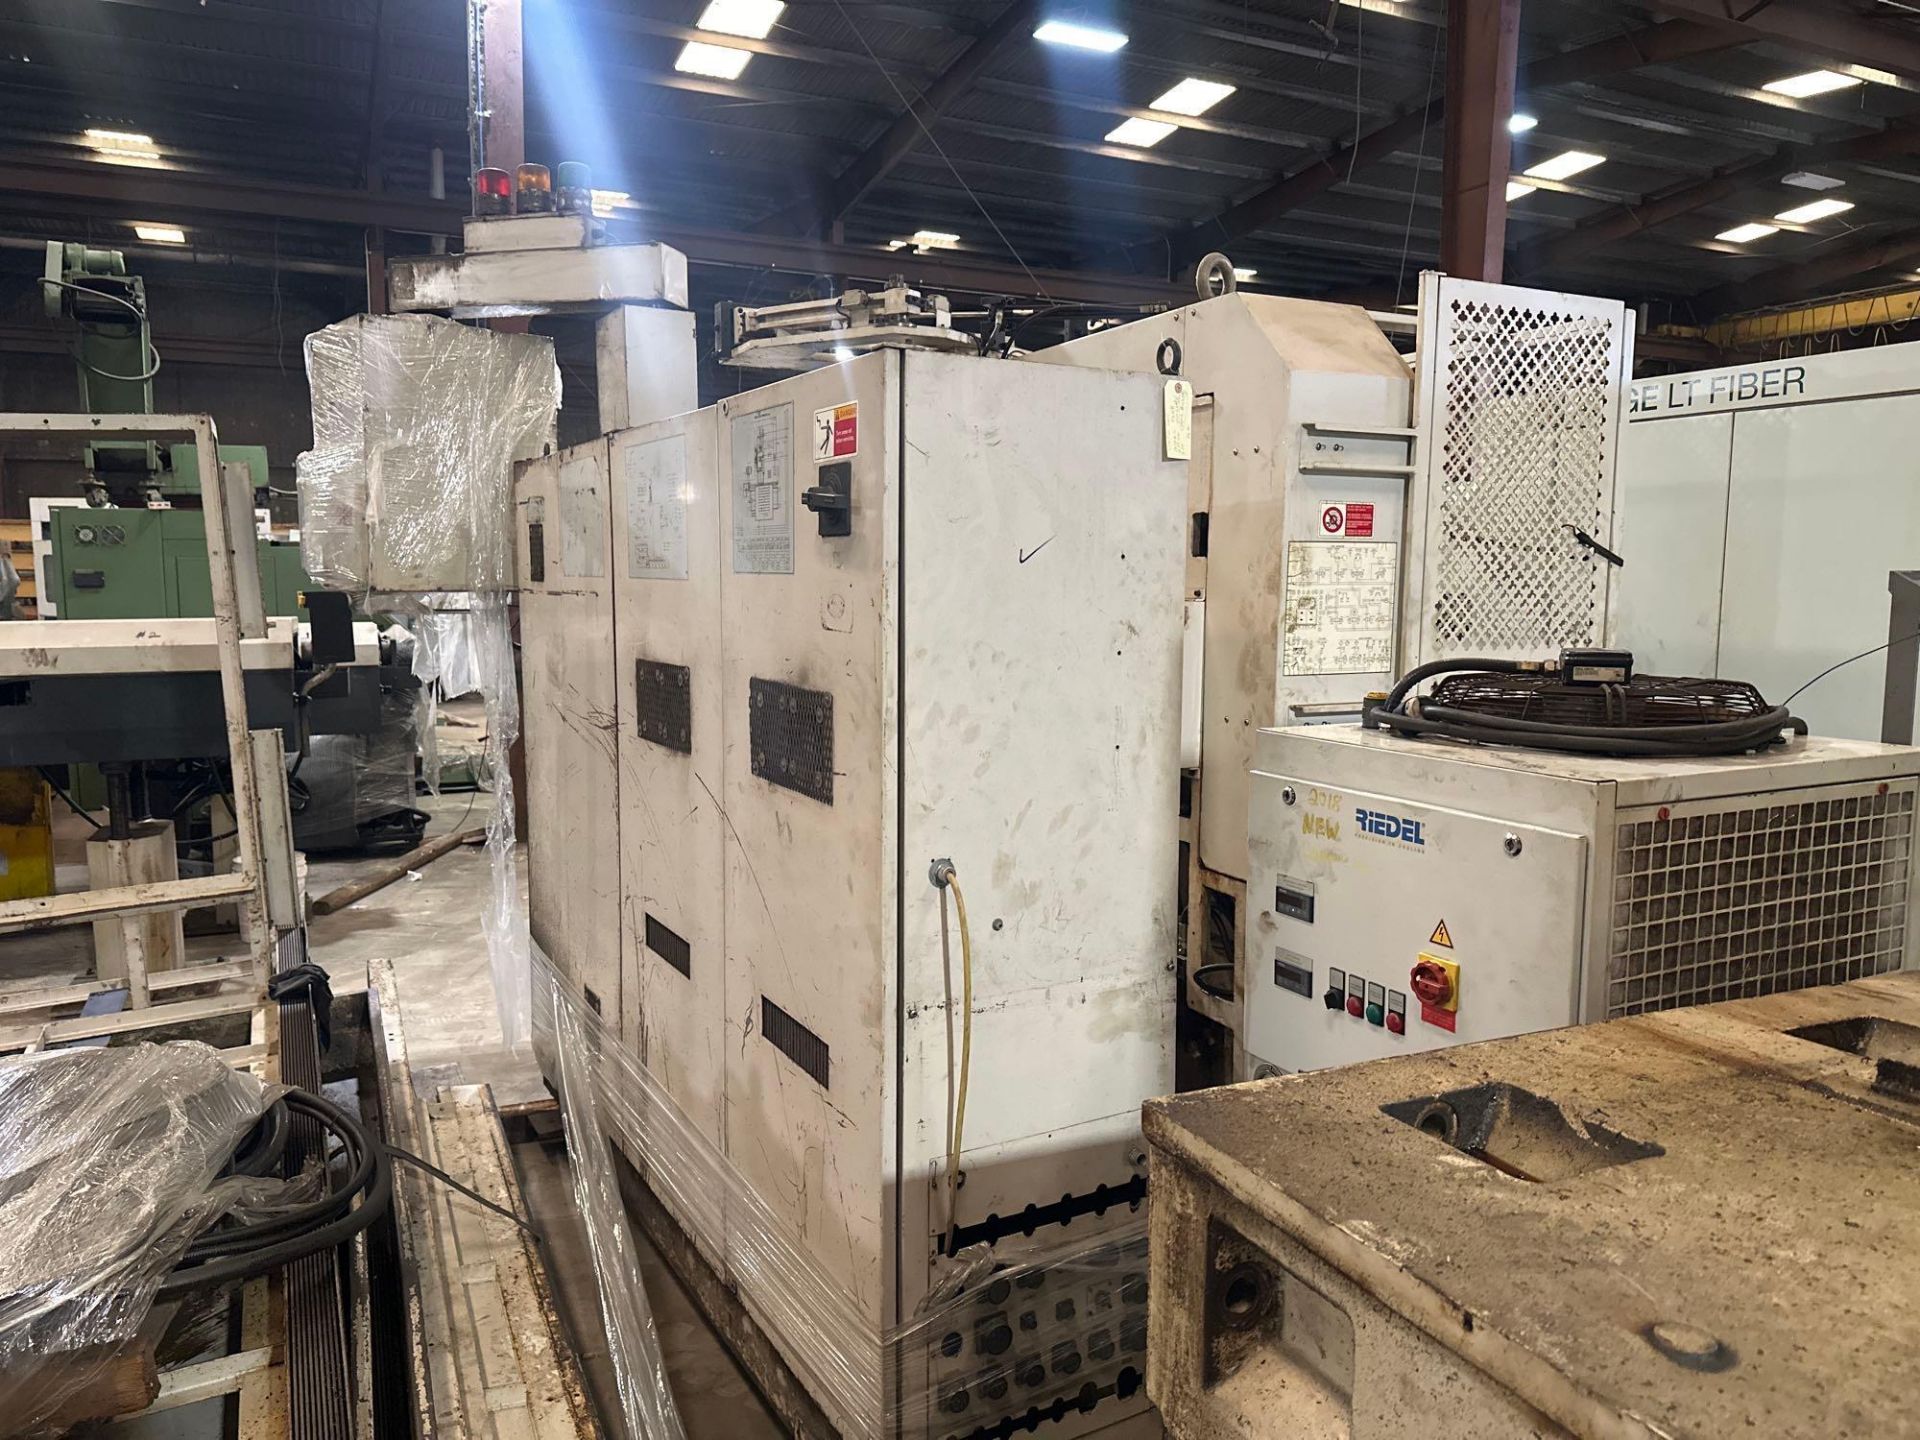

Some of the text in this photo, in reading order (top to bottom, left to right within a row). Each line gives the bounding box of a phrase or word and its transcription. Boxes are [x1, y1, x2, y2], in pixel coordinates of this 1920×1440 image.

[1668, 379, 1702, 408] LT
[1709, 366, 1806, 404] FIBER
[1302, 812, 1341, 840] NEW
